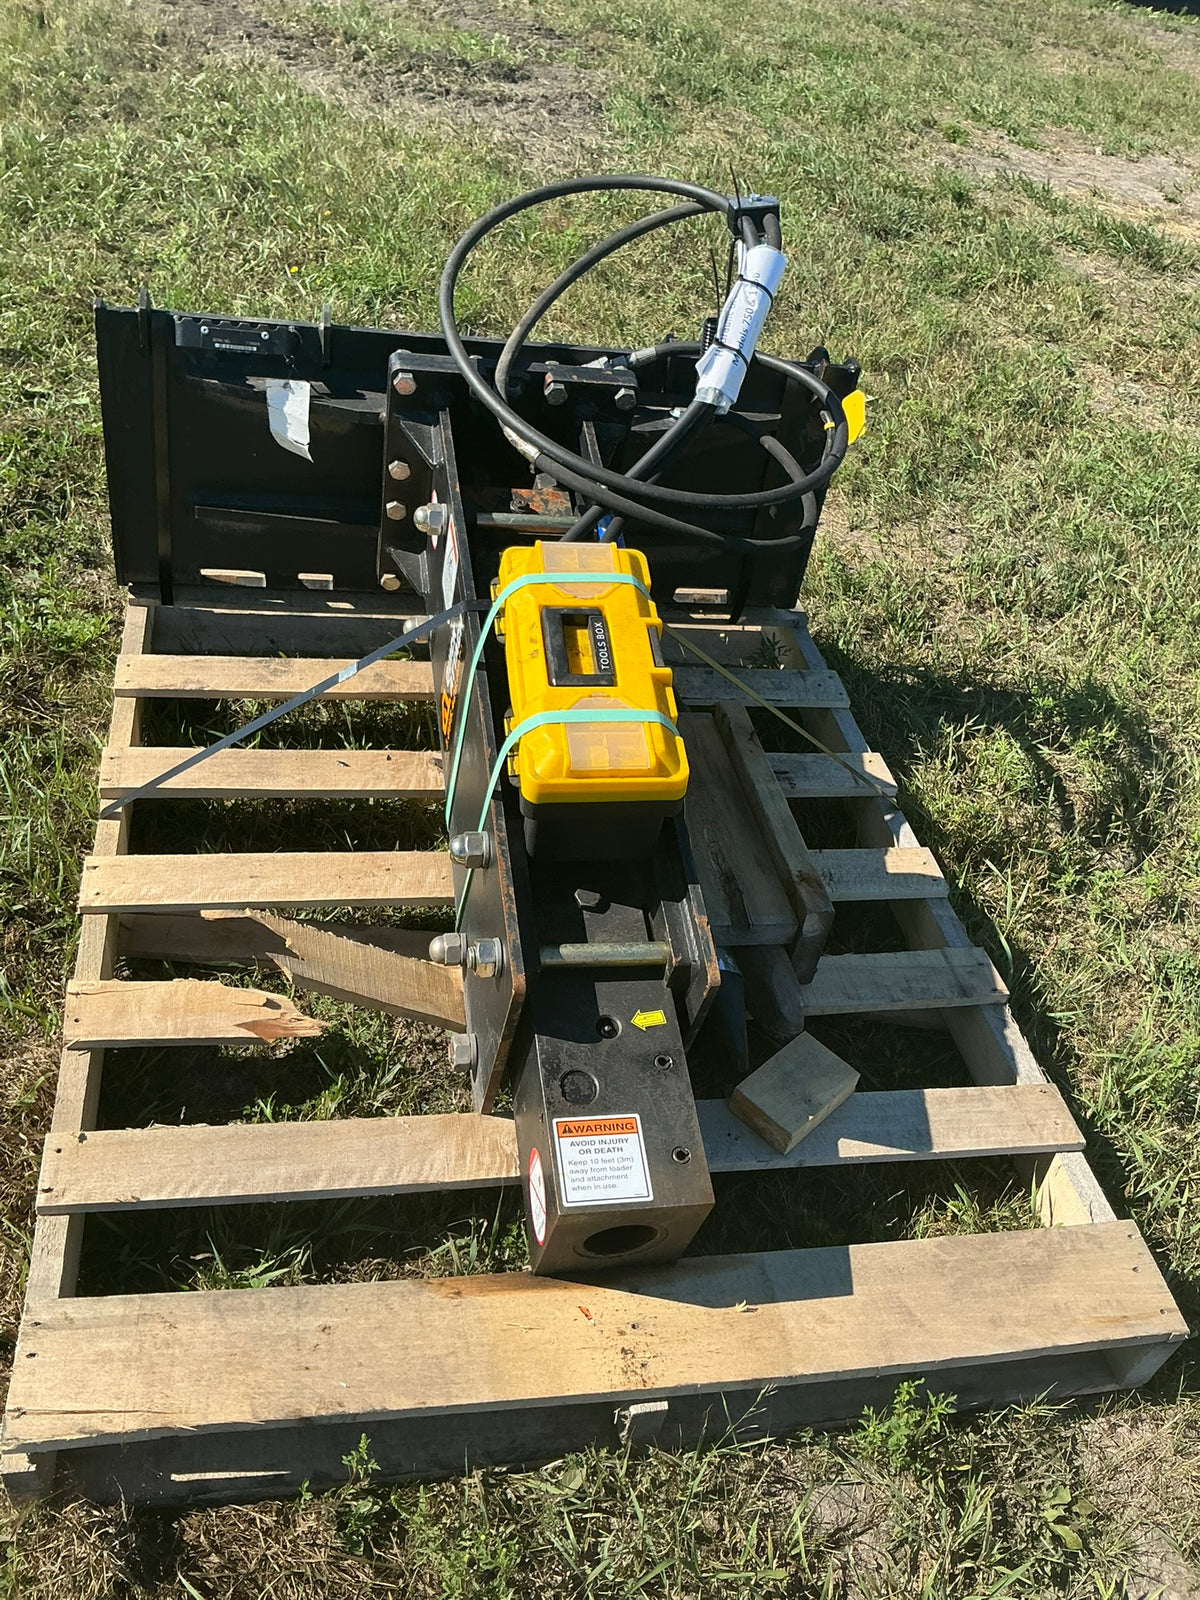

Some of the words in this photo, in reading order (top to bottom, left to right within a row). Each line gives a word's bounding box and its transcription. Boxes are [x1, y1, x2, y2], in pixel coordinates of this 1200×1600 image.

[742, 307, 754, 326] 750
[594, 622, 605, 640] BOX
[598, 641, 610, 670] TOOLS
[573, 1122, 634, 1133] WARNING
[598, 1138, 629, 1146] INJURY
[568, 1159, 588, 1167] Keep
[616, 1156, 634, 1164] (3m)
[587, 1173, 629, 1182] attachment
